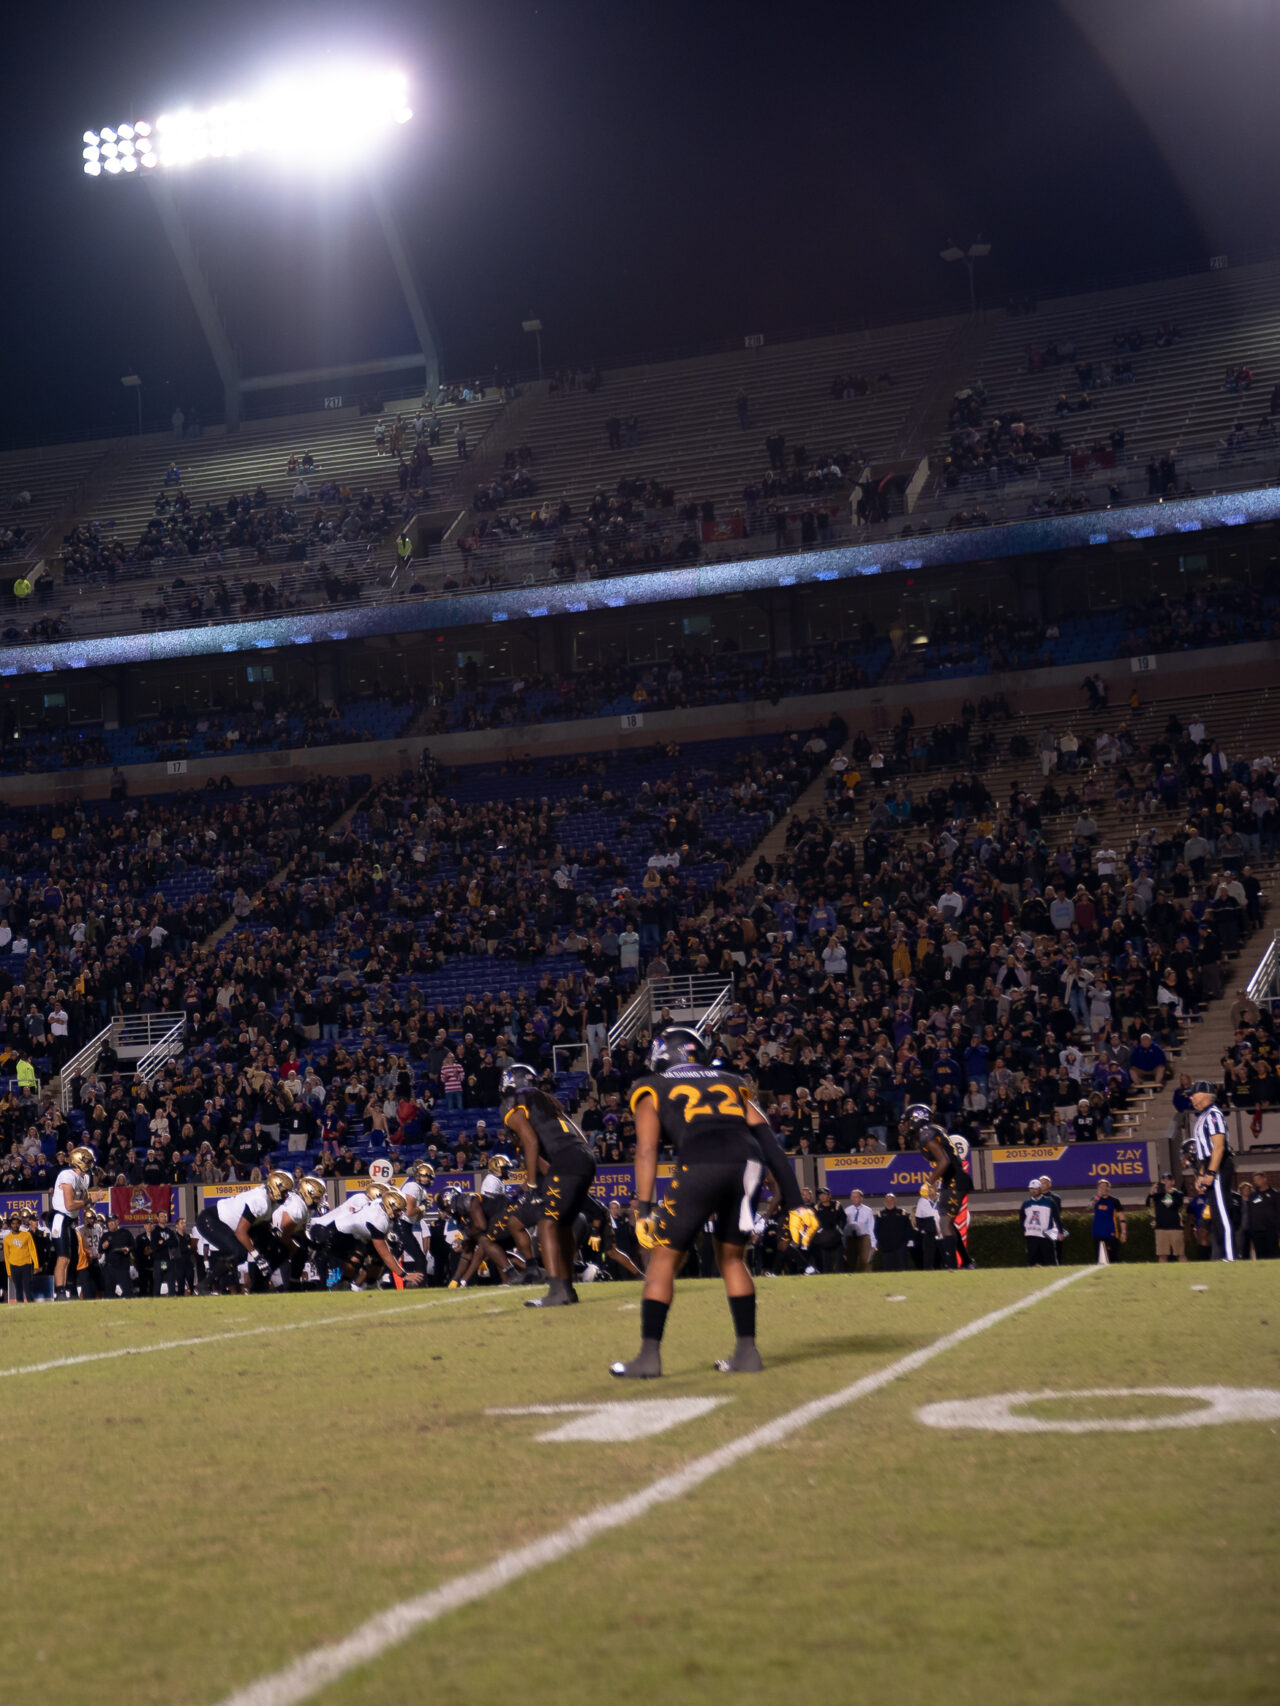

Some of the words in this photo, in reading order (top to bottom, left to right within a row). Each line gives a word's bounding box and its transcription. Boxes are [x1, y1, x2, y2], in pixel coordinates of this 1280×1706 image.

[1138, 657, 1149, 669] 19
[626, 716, 637, 727] 18
[173, 763, 181, 772] 17
[669, 1084, 745, 1123] 22
[1005, 1149, 1054, 1159] 2013-2016
[1116, 1149, 1142, 1160] ZAY
[834, 1157, 885, 1167] 2004-2007
[372, 1165, 390, 1177] P6
[1088, 1161, 1144, 1177] JONES
[446, 1180, 470, 1189] TOM
[592, 1174, 631, 1184] LESTER
[610, 1185, 631, 1196] JR.
[6, 1200, 38, 1209] TERRY
